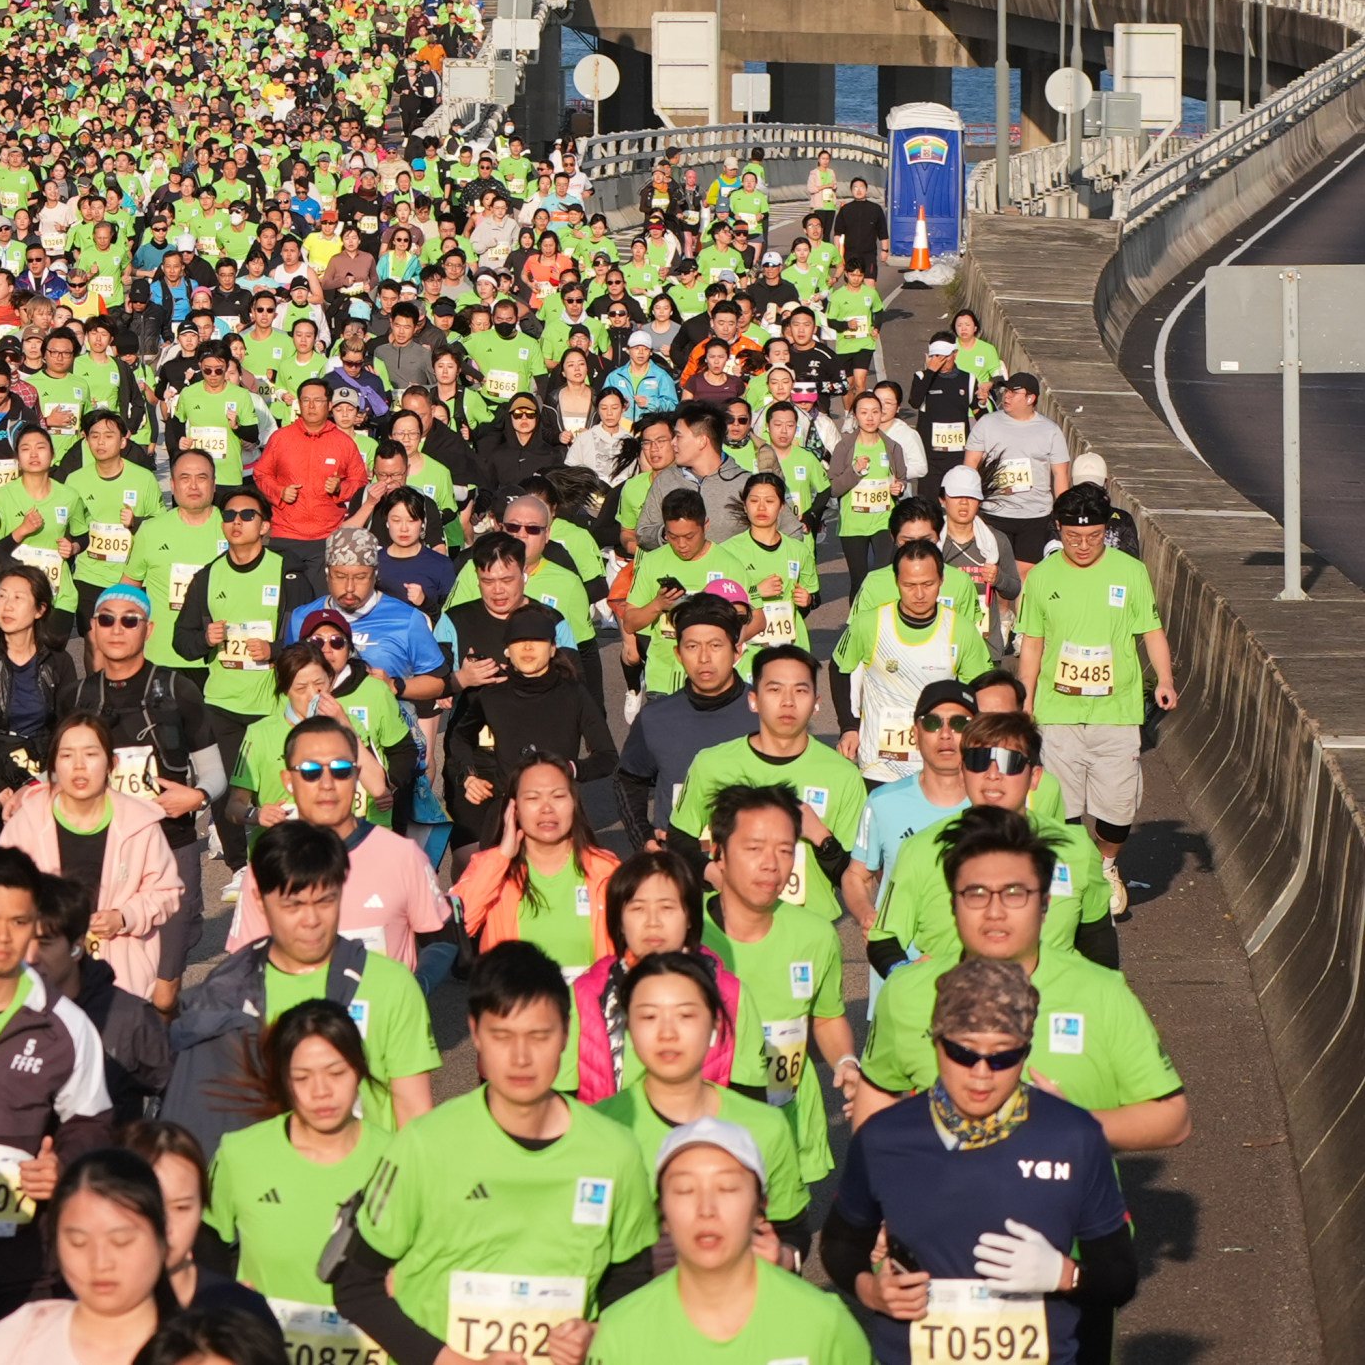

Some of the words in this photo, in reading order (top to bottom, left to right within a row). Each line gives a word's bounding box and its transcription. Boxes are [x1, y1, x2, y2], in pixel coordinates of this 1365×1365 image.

[90, 283, 113, 292] T2735
[488, 379, 516, 392] T3665
[192, 438, 225, 450] T1425
[934, 433, 964, 444] T0516
[854, 489, 888, 503] T1869
[91, 535, 128, 552] T2805
[1060, 661, 1111, 681] T3485
[884, 729, 917, 746] T18
[458, 1317, 550, 1357] T262
[920, 1324, 1040, 1361] T0592
